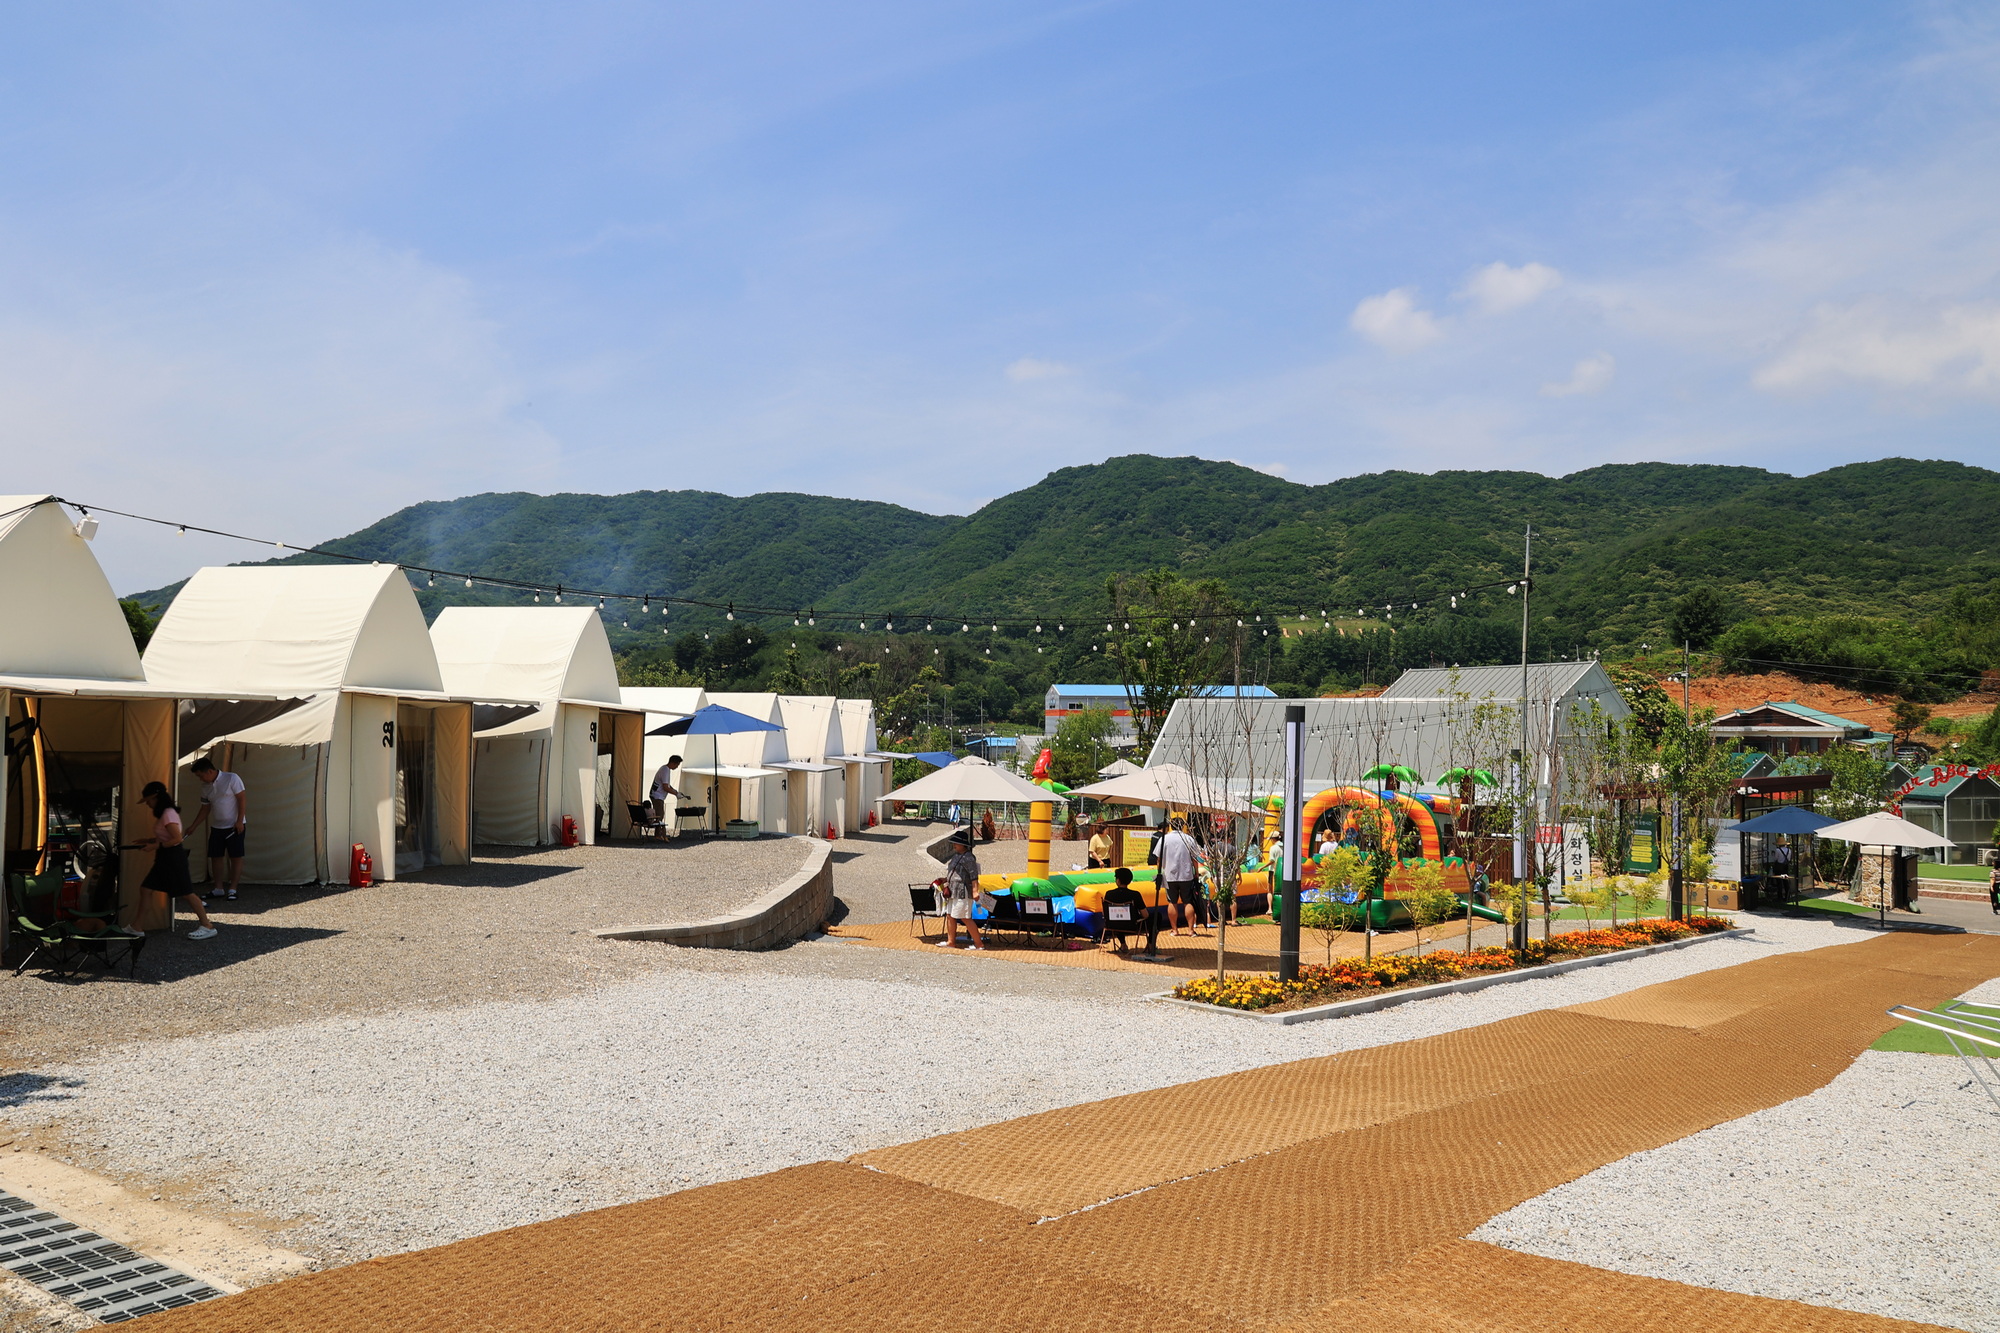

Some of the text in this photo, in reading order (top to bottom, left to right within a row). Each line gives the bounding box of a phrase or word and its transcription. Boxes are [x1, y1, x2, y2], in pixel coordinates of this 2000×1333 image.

[382, 720, 394, 748] 28
[1929, 764, 1972, 787] BBQ
[1570, 837, 1583, 882] 화장실
